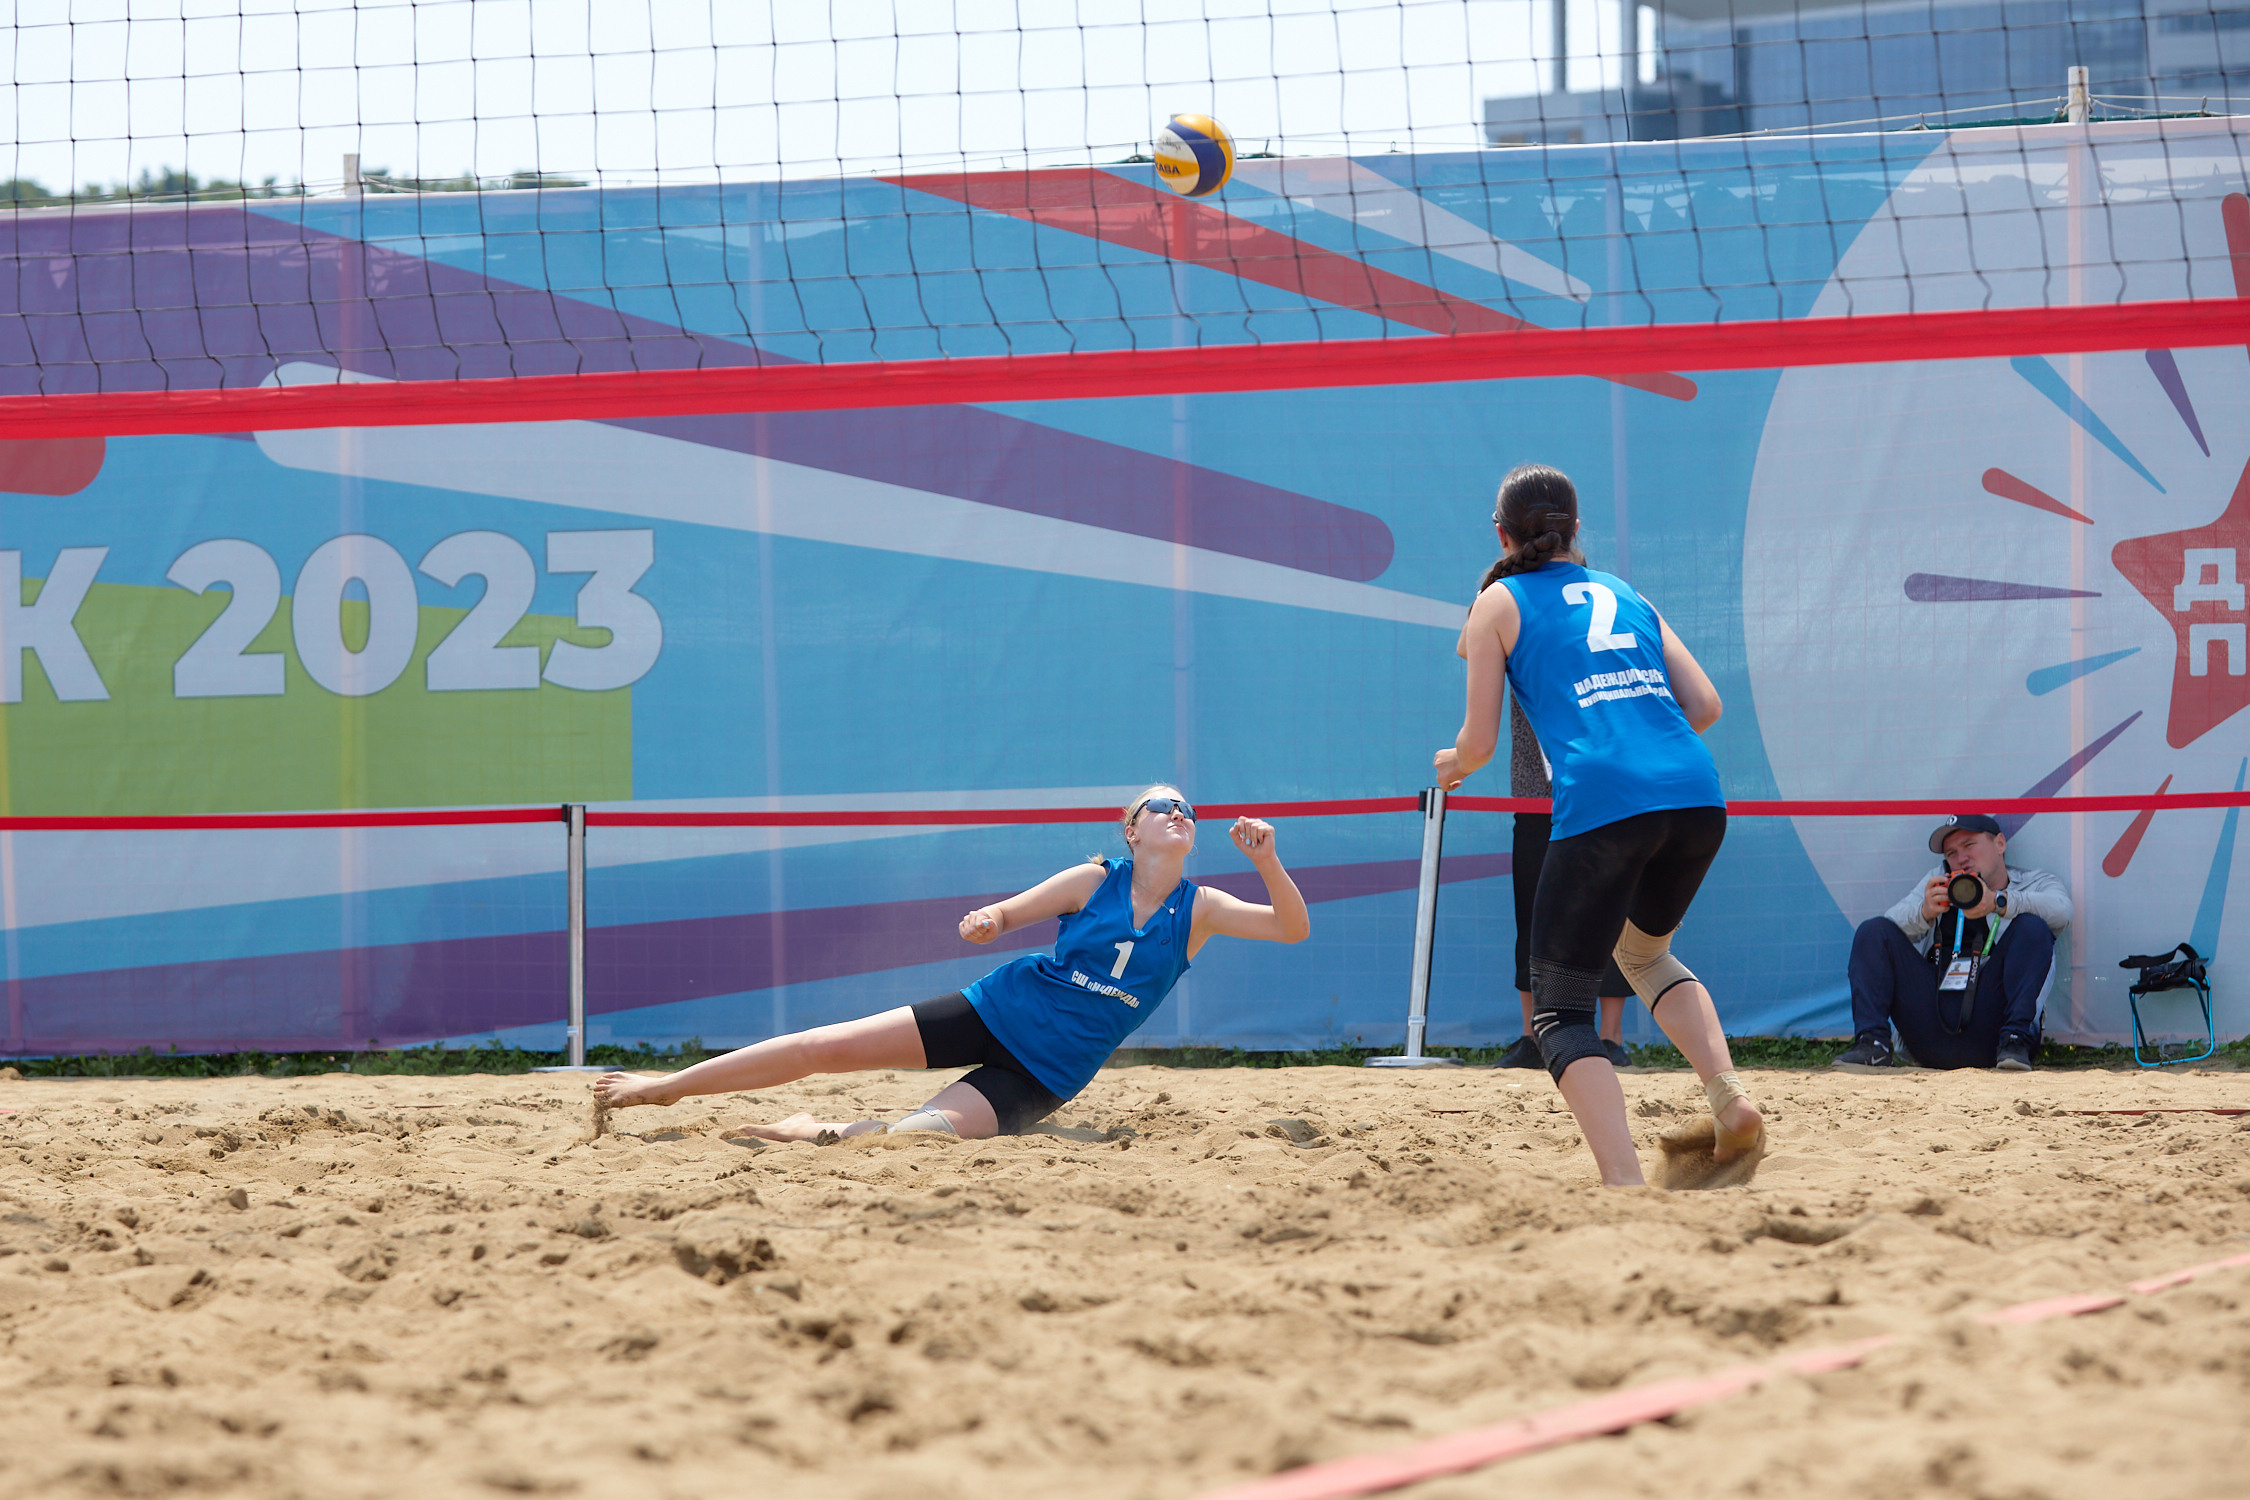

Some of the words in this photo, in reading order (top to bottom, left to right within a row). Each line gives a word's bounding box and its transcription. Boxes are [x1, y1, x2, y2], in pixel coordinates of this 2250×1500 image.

[164, 528, 663, 698] 2023
[1561, 581, 1638, 653] 2
[1071, 970, 1090, 987] СШ
[1110, 940, 1135, 980] 1
[1969, 955, 1979, 984] SONY
